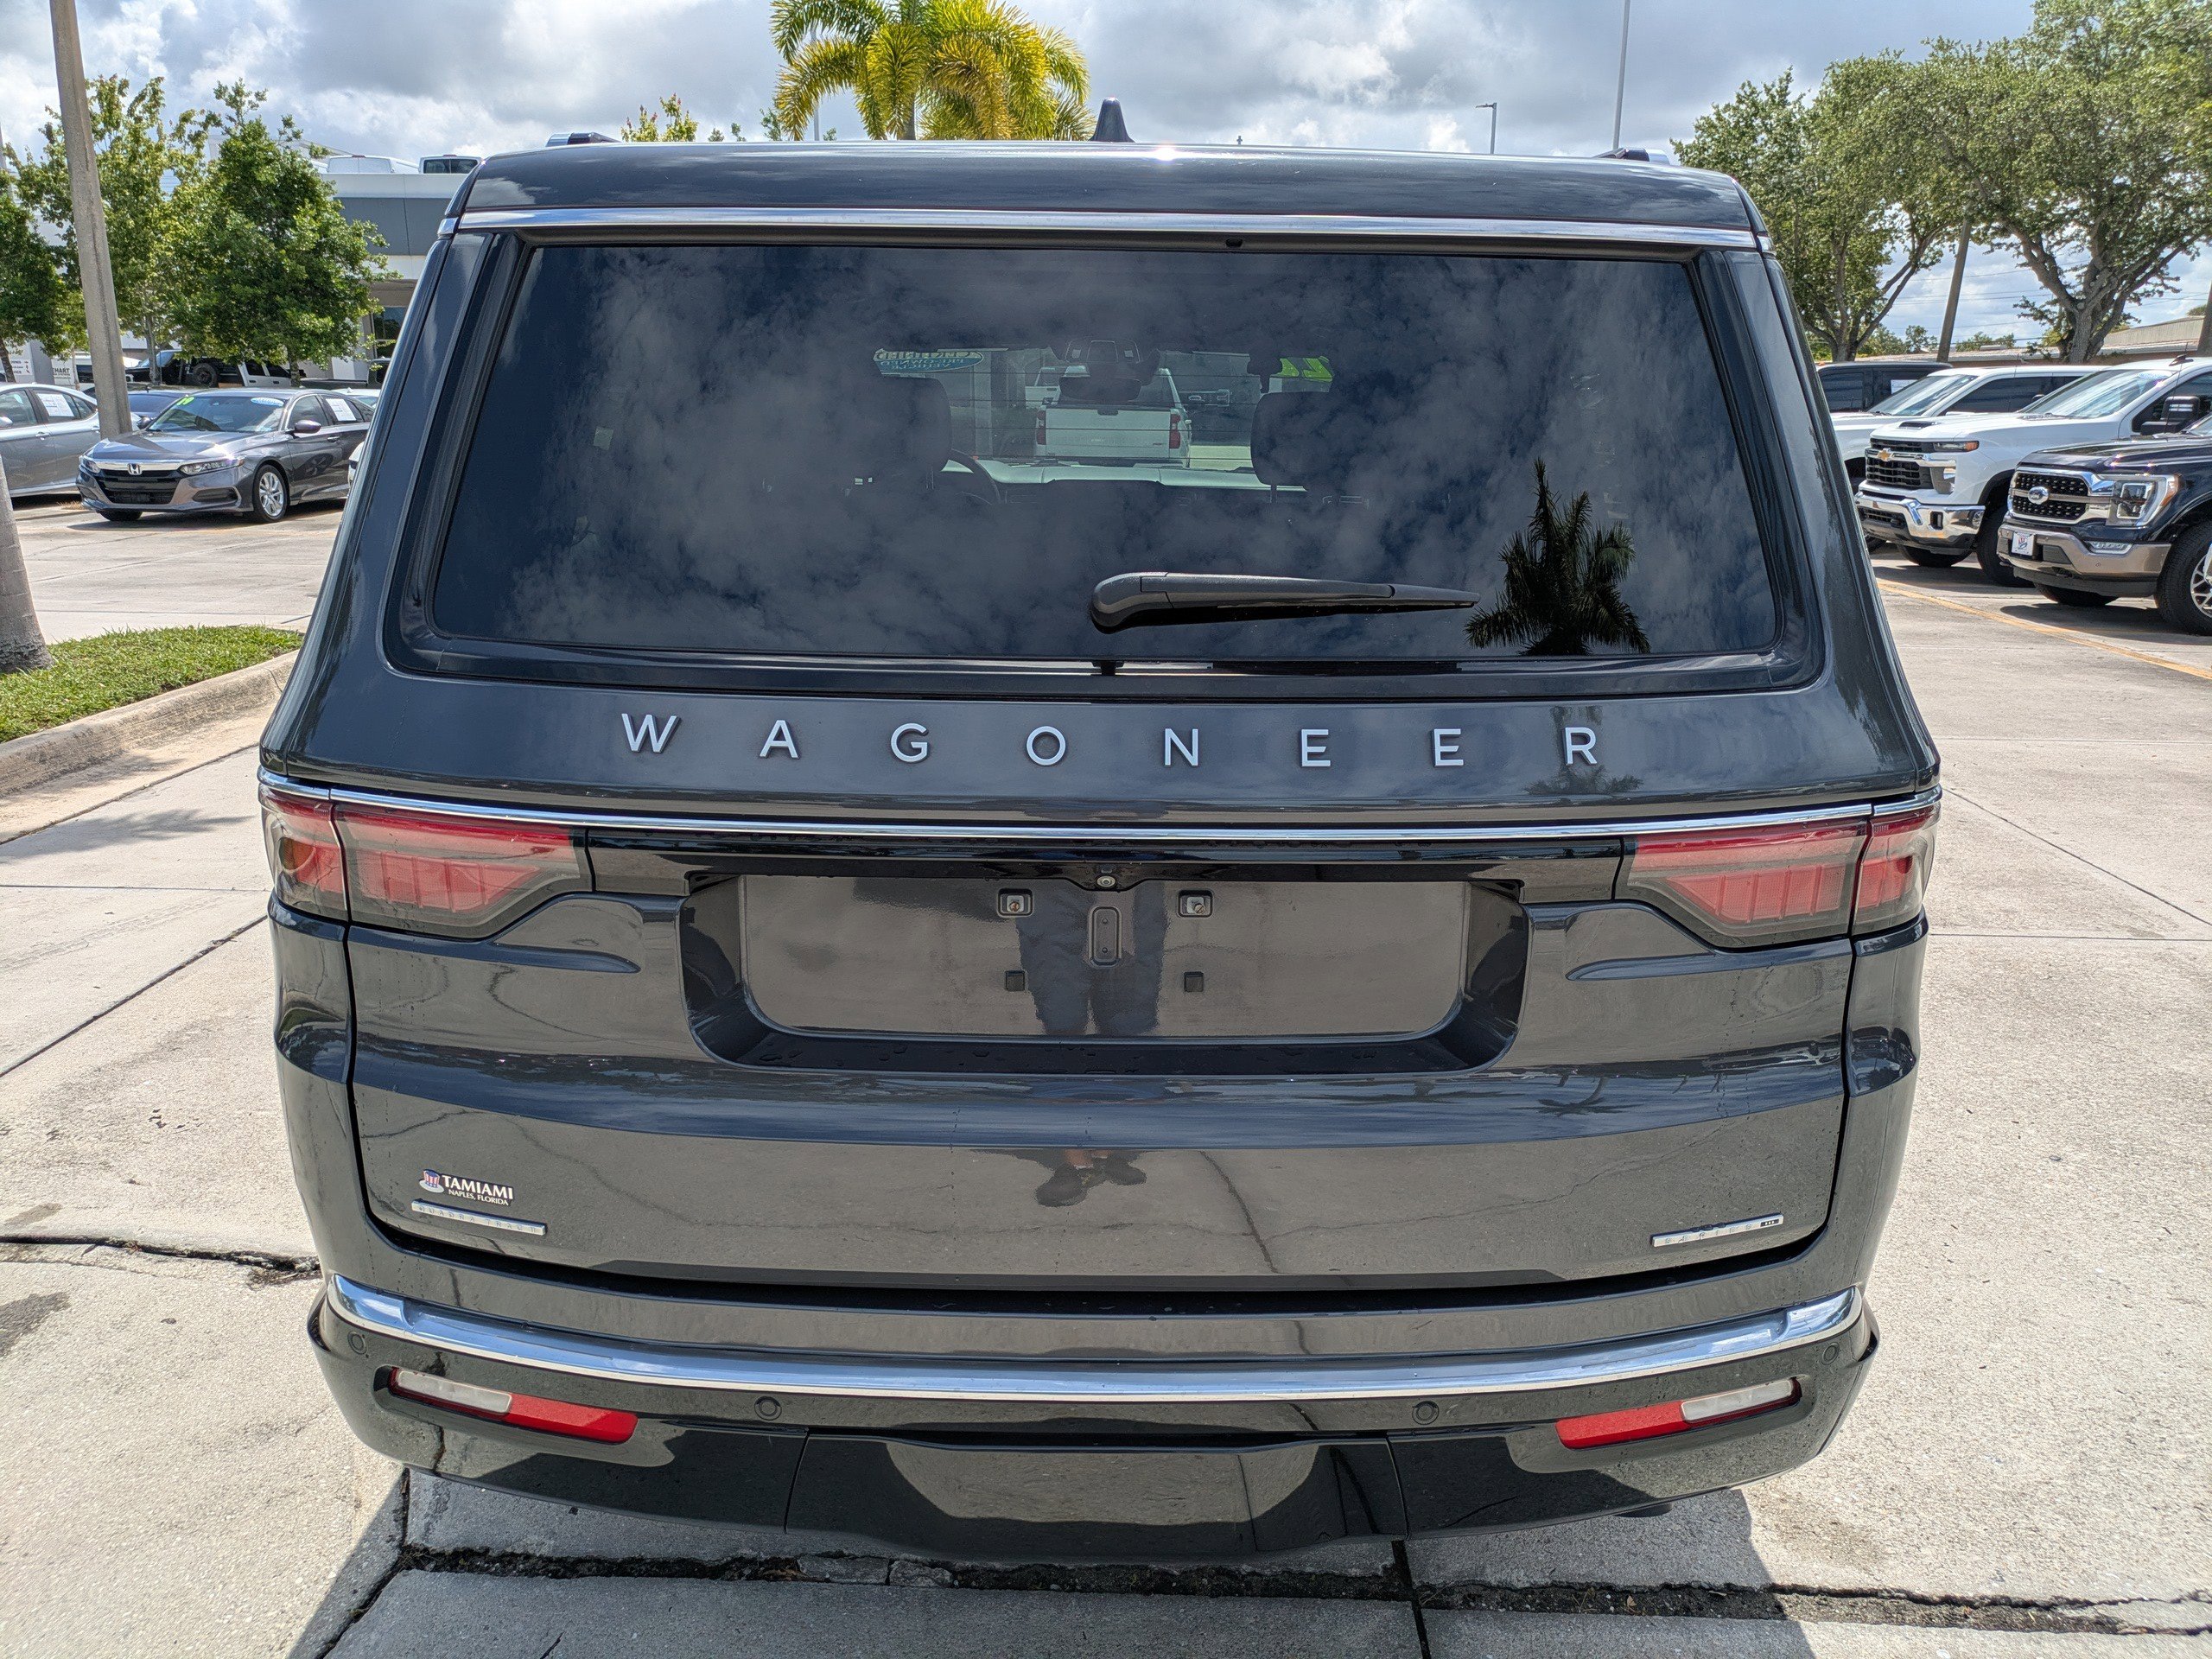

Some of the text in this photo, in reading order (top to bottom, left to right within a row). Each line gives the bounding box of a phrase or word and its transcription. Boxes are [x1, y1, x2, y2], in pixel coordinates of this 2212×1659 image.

[621, 713, 1598, 768] WAGONEER
[442, 1174, 513, 1200] TAMIAMI
[448, 1189, 509, 1206] NAPLES, FLORIDA
